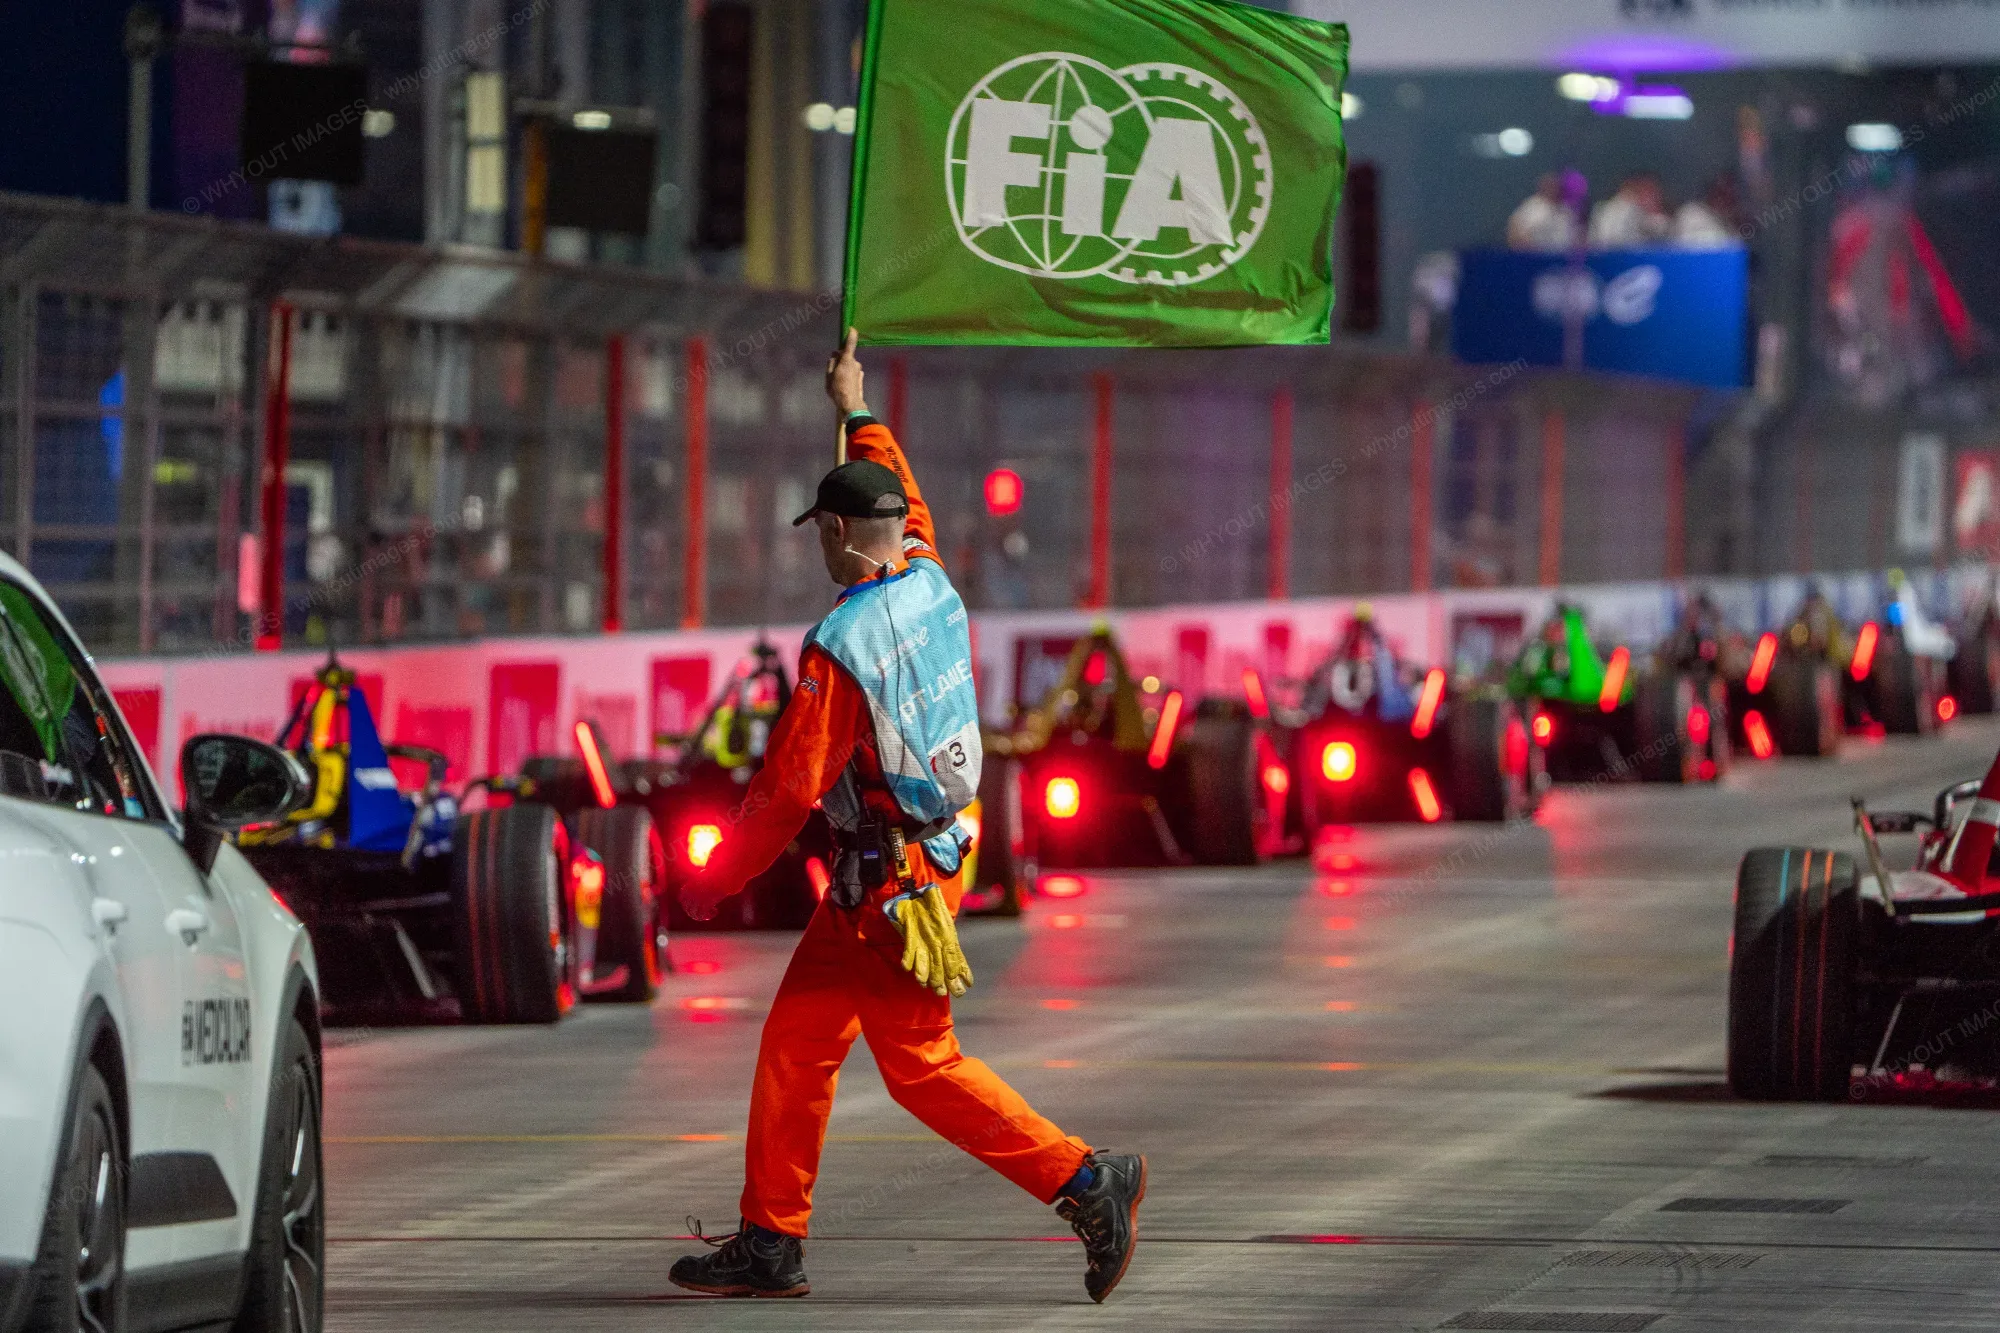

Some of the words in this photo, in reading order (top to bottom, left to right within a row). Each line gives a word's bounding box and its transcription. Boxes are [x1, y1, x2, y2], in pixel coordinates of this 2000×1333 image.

[899, 688, 929, 725] PT
[927, 658, 972, 703] LANE
[949, 741, 967, 767] 3
